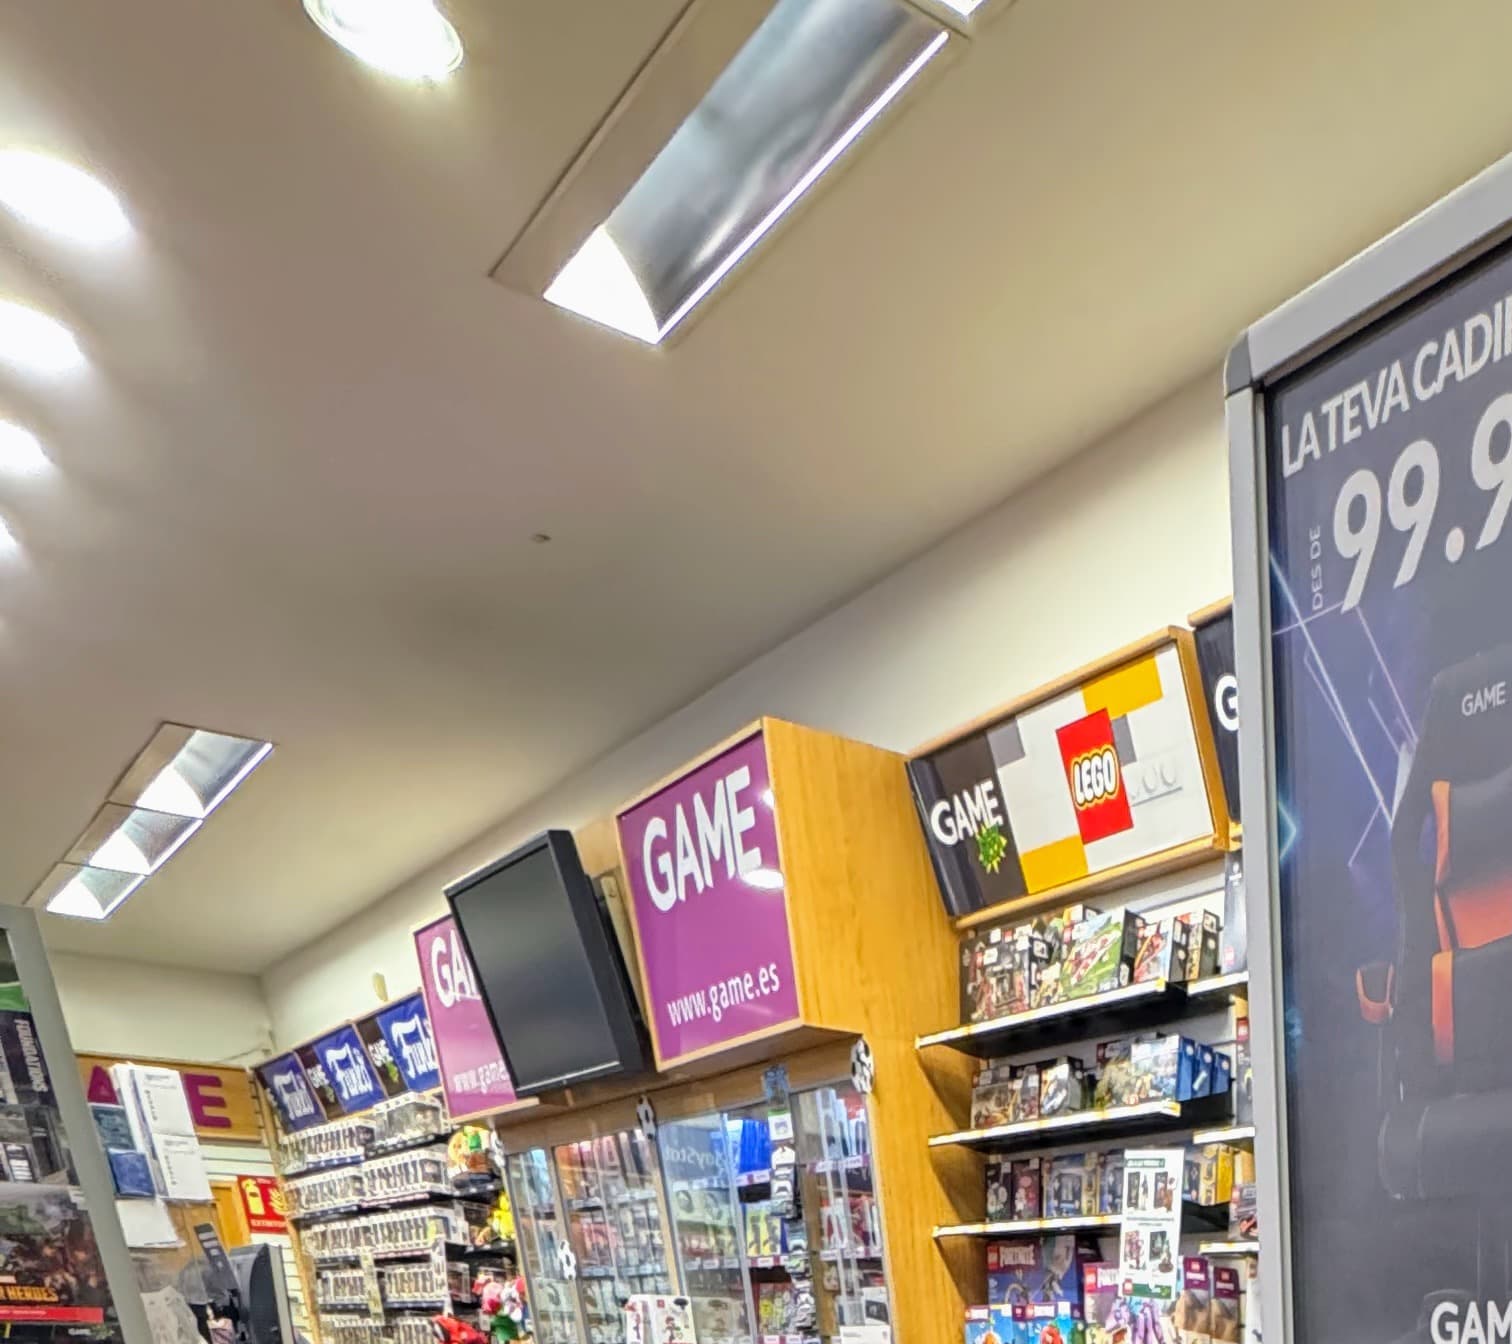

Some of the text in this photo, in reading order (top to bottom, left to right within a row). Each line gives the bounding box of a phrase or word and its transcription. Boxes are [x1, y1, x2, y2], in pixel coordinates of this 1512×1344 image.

[1282, 414, 1320, 478] LA
[1320, 360, 1409, 454] TEVA
[1461, 681, 1507, 716] GAME
[1072, 747, 1119, 809] LEGO
[642, 766, 762, 911] GAME
[931, 781, 1003, 845] GAME
[667, 962, 781, 1027] www.game.es
